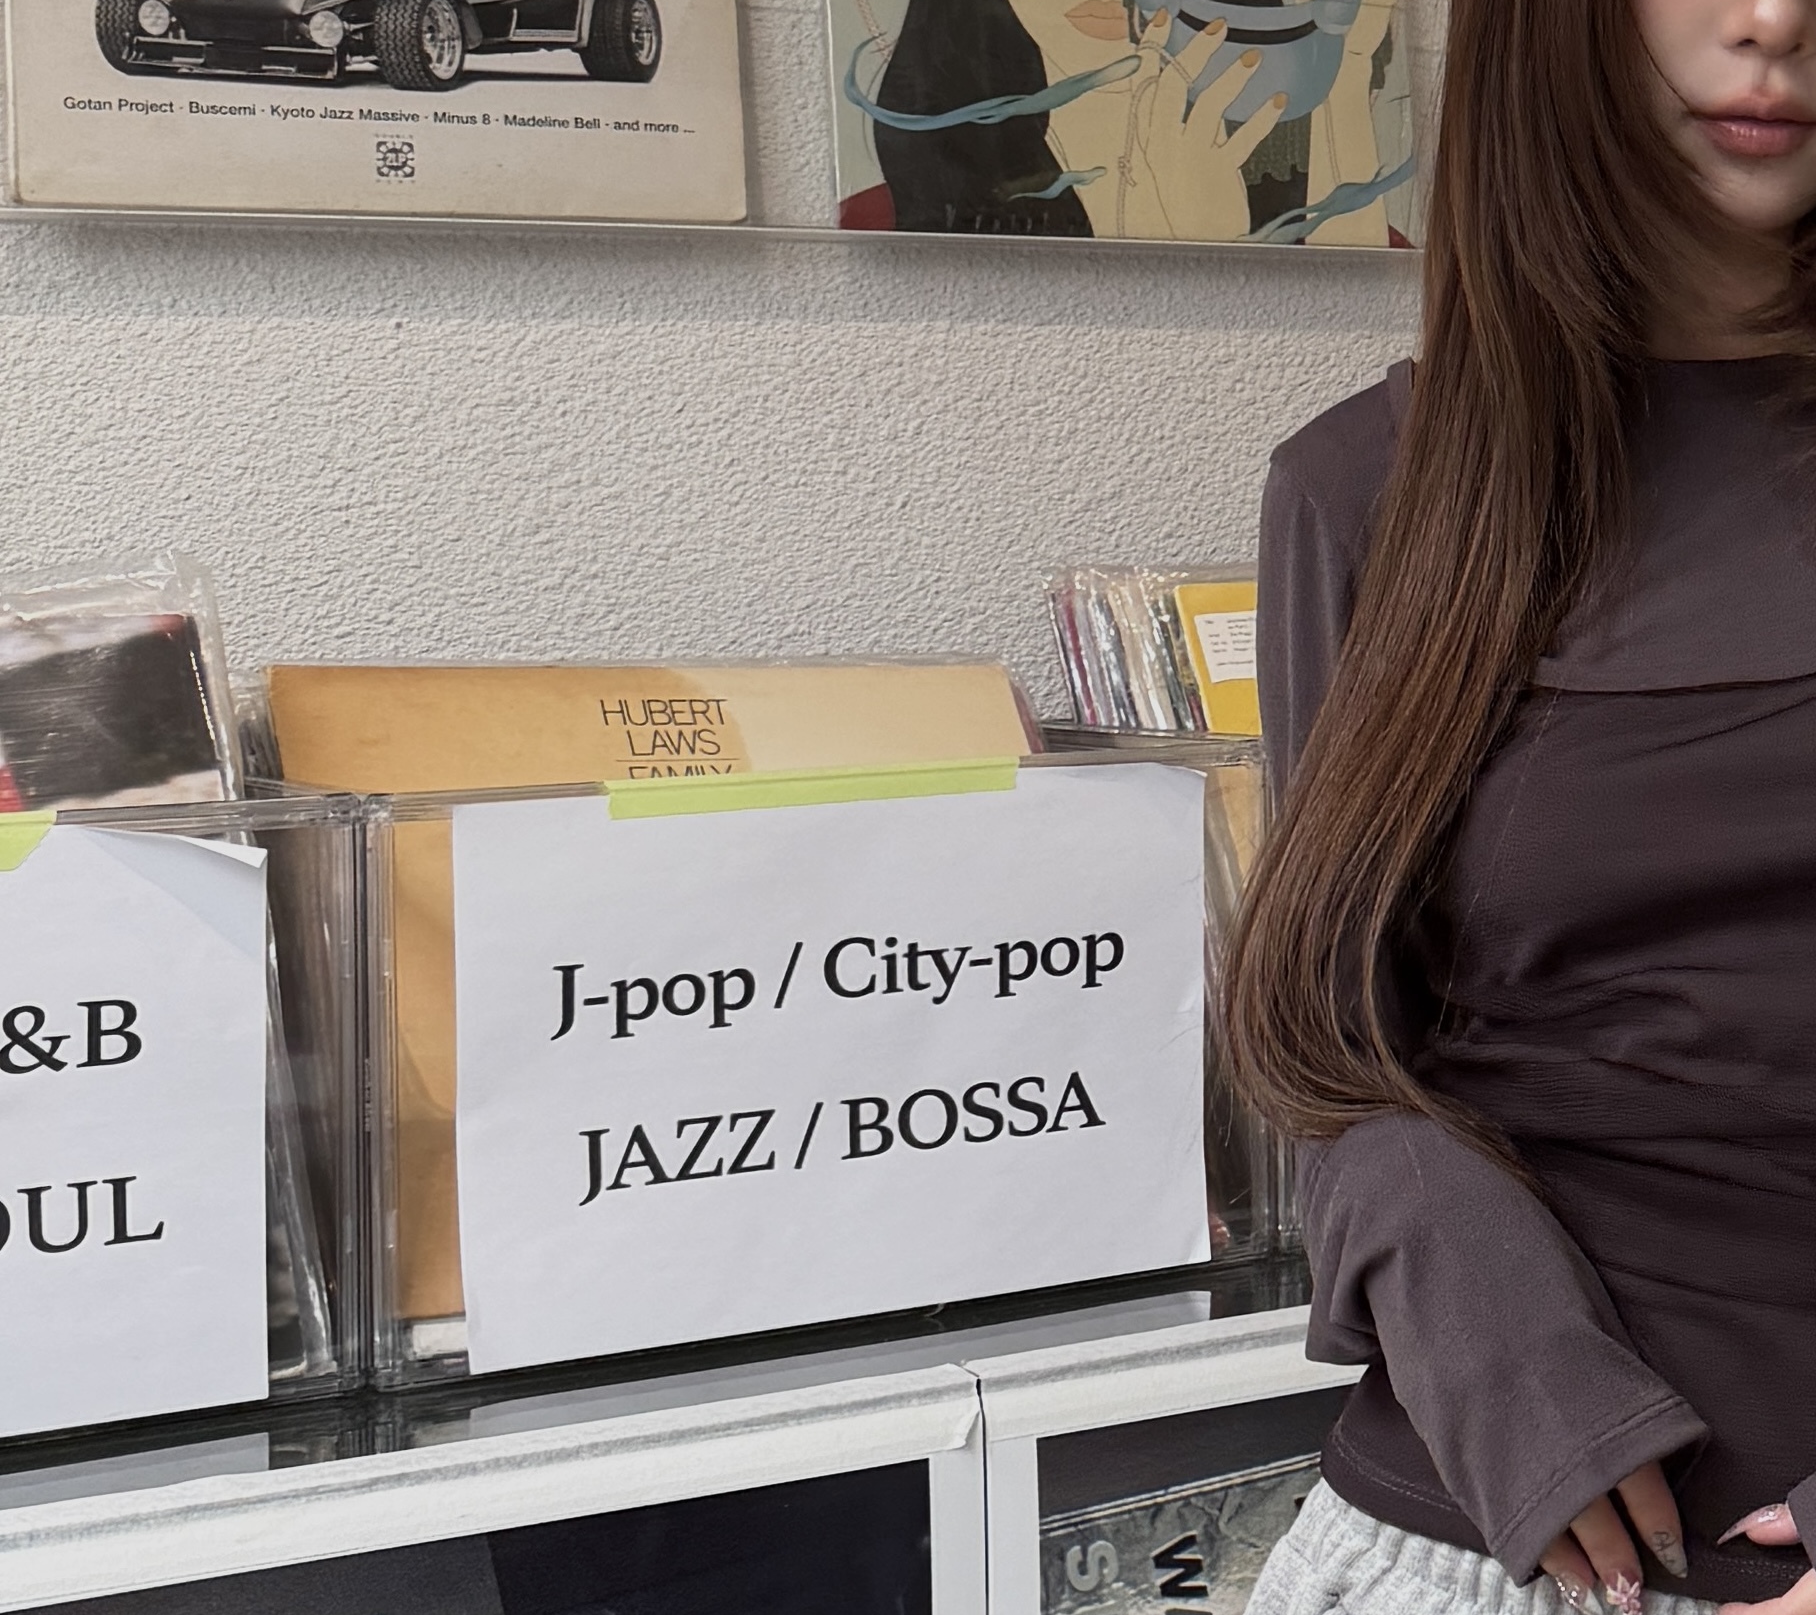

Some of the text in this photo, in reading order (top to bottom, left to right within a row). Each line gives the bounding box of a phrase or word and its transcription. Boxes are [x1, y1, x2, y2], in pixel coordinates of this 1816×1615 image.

[62, 95, 679, 135] Gotan Project Buscemi Kyoto Jazz Massive Minus 8 Madeline Bell and more
[599, 698, 729, 727] HUBERT
[626, 728, 722, 757] LAWS
[550, 926, 1127, 1042] J-pop / City-pop
[578, 1070, 1108, 1208] JAZZ / BOSSA
